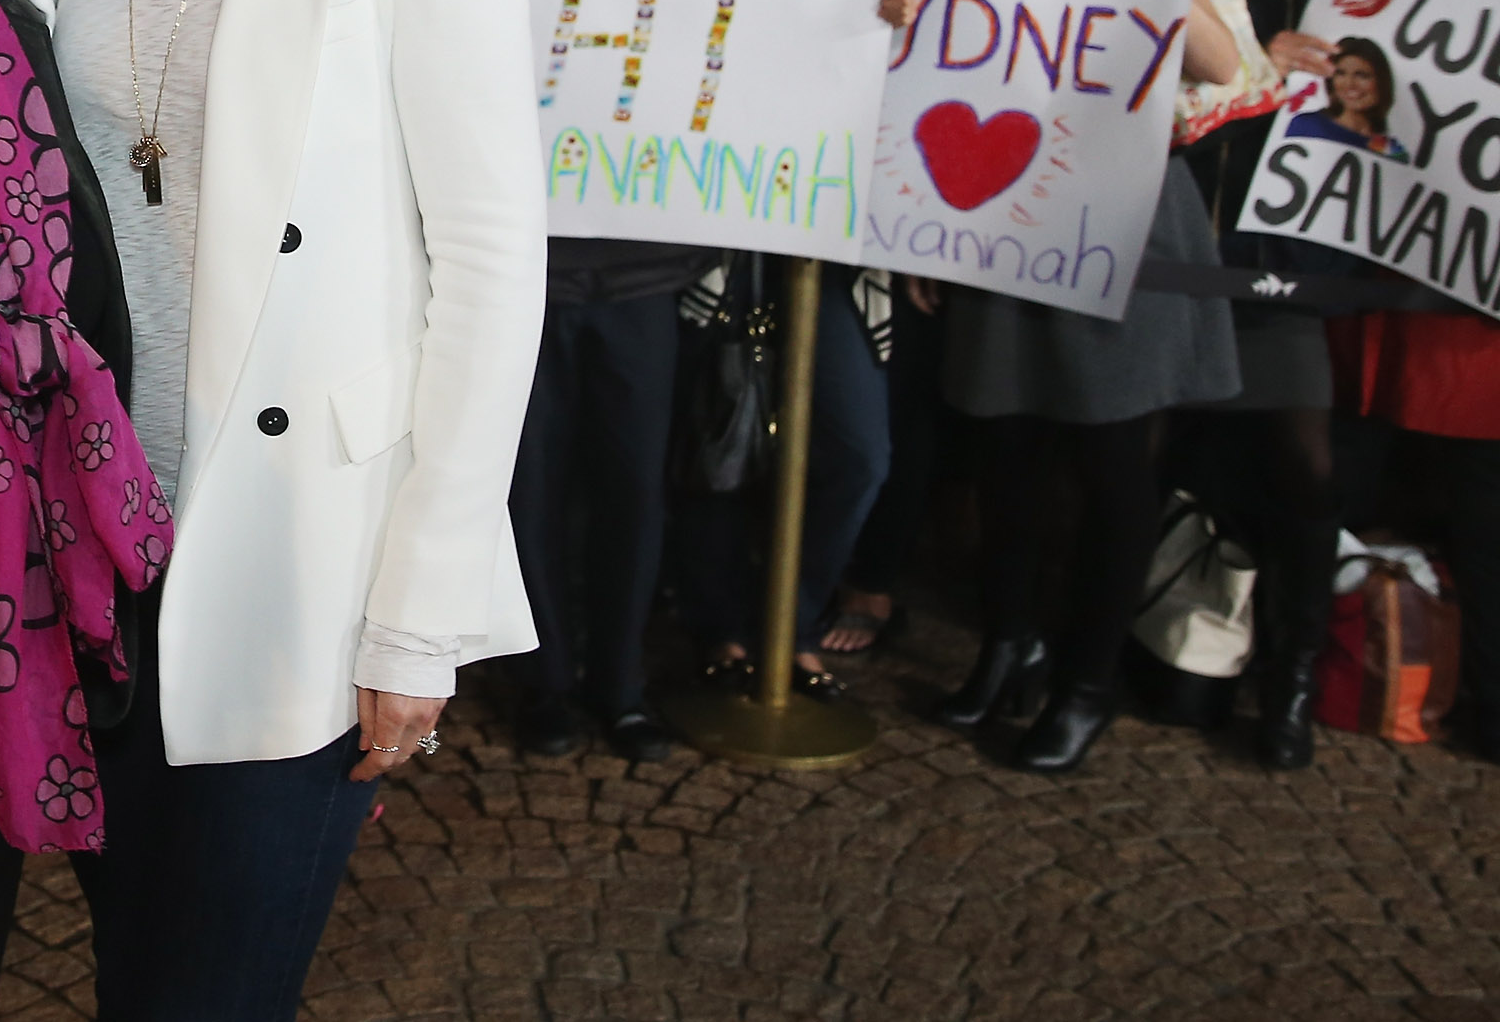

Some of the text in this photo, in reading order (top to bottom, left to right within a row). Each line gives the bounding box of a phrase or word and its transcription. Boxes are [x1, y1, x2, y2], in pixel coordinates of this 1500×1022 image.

[547, 126, 860, 240] AVANNAH
[1254, 143, 1500, 312] SAVAN
[864, 203, 1117, 299] vannah
